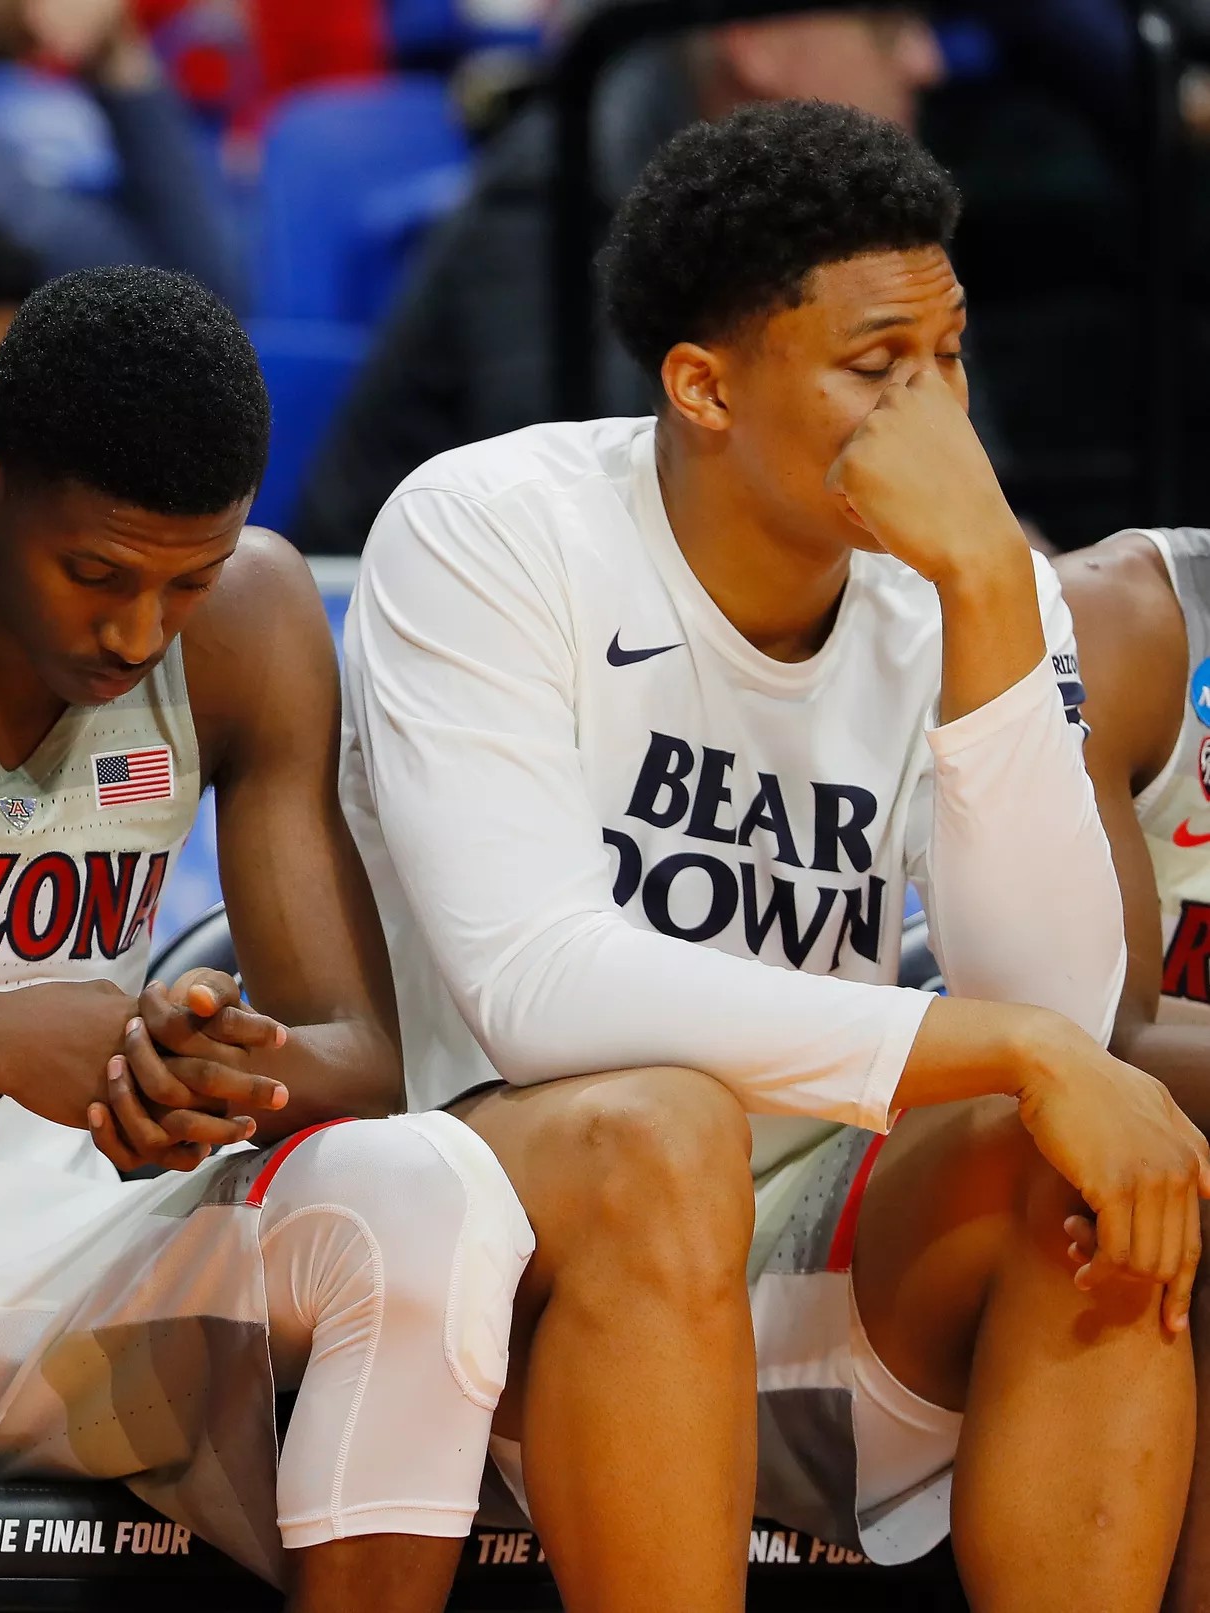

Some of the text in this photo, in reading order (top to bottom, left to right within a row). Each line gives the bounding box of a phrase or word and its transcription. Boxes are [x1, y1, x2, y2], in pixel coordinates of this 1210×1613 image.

[1052, 654, 1077, 675] RIZO
[624, 730, 878, 873] BEAR
[24, 1519, 106, 1553] FINAL
[114, 1521, 190, 1555] FOUR
[477, 1533, 533, 1564] THE
[748, 1530, 800, 1564] NAL
